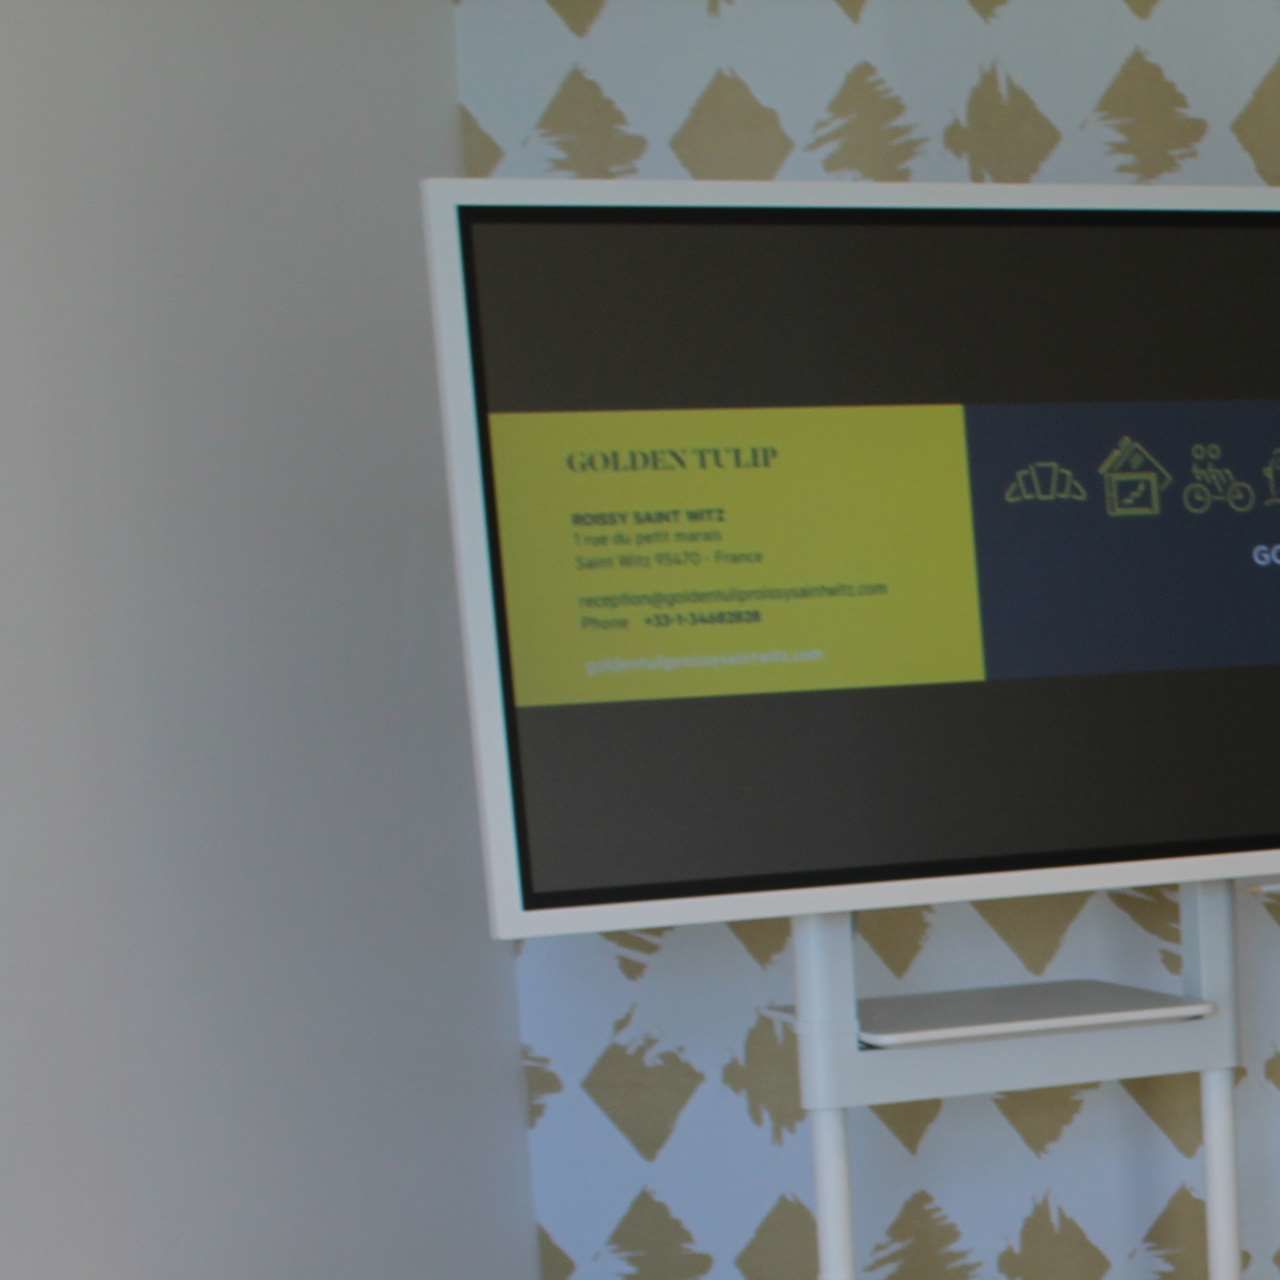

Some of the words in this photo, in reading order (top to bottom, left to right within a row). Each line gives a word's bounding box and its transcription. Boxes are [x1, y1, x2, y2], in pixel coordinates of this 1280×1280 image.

[566, 449, 686, 472] GOLDEN
[694, 446, 778, 470] TULIP
[571, 511, 627, 525] ROISSY
[632, 509, 681, 524] SAINT
[687, 507, 725, 522] WITZ
